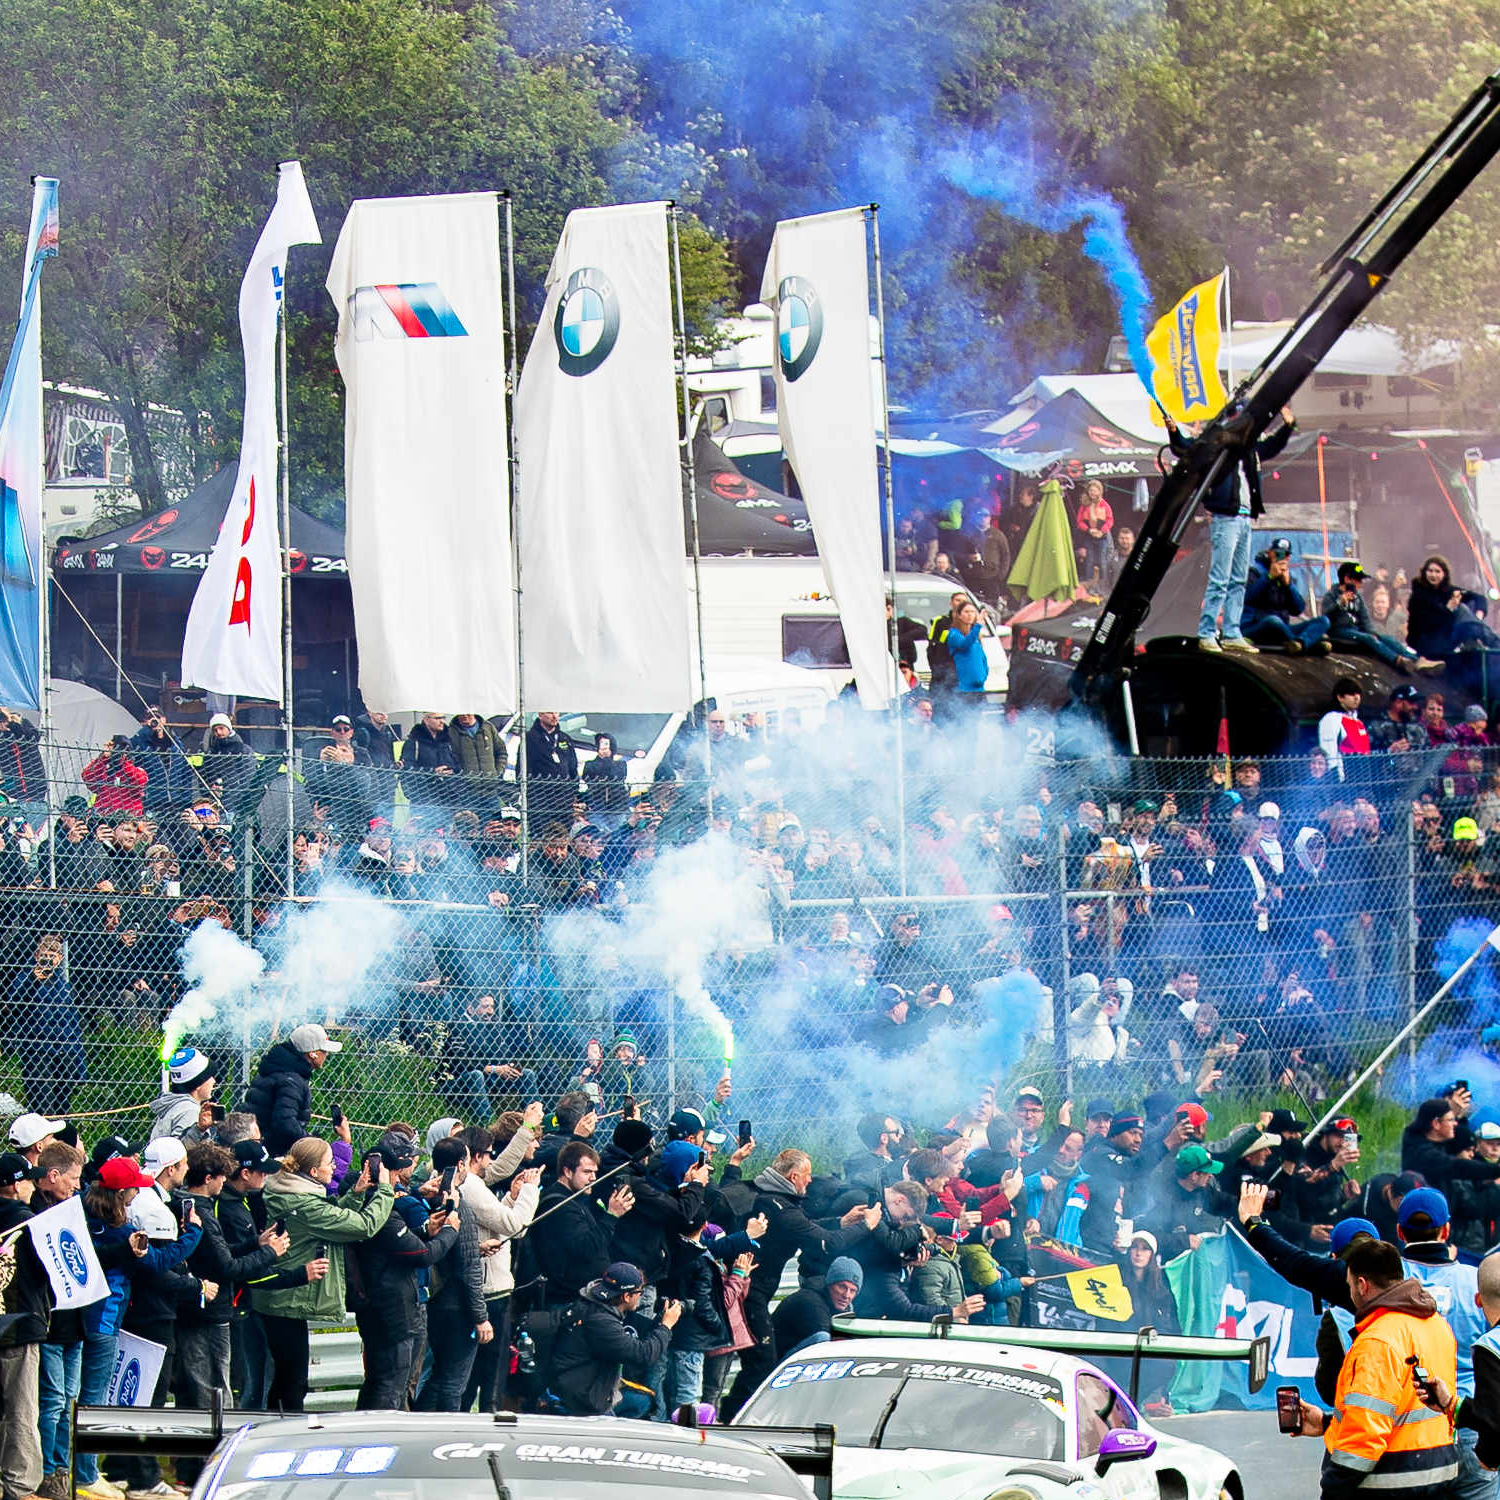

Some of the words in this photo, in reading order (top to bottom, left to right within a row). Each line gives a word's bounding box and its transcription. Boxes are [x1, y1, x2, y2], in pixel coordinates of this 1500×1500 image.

[45, 1232, 73, 1298] RACING
[60, 1240, 86, 1284] Ford
[107, 1349, 125, 1406] RACIN
[964, 1367, 1056, 1396] TURISMO
[515, 1443, 610, 1464] GRAN
[612, 1446, 755, 1479] TURISMO
